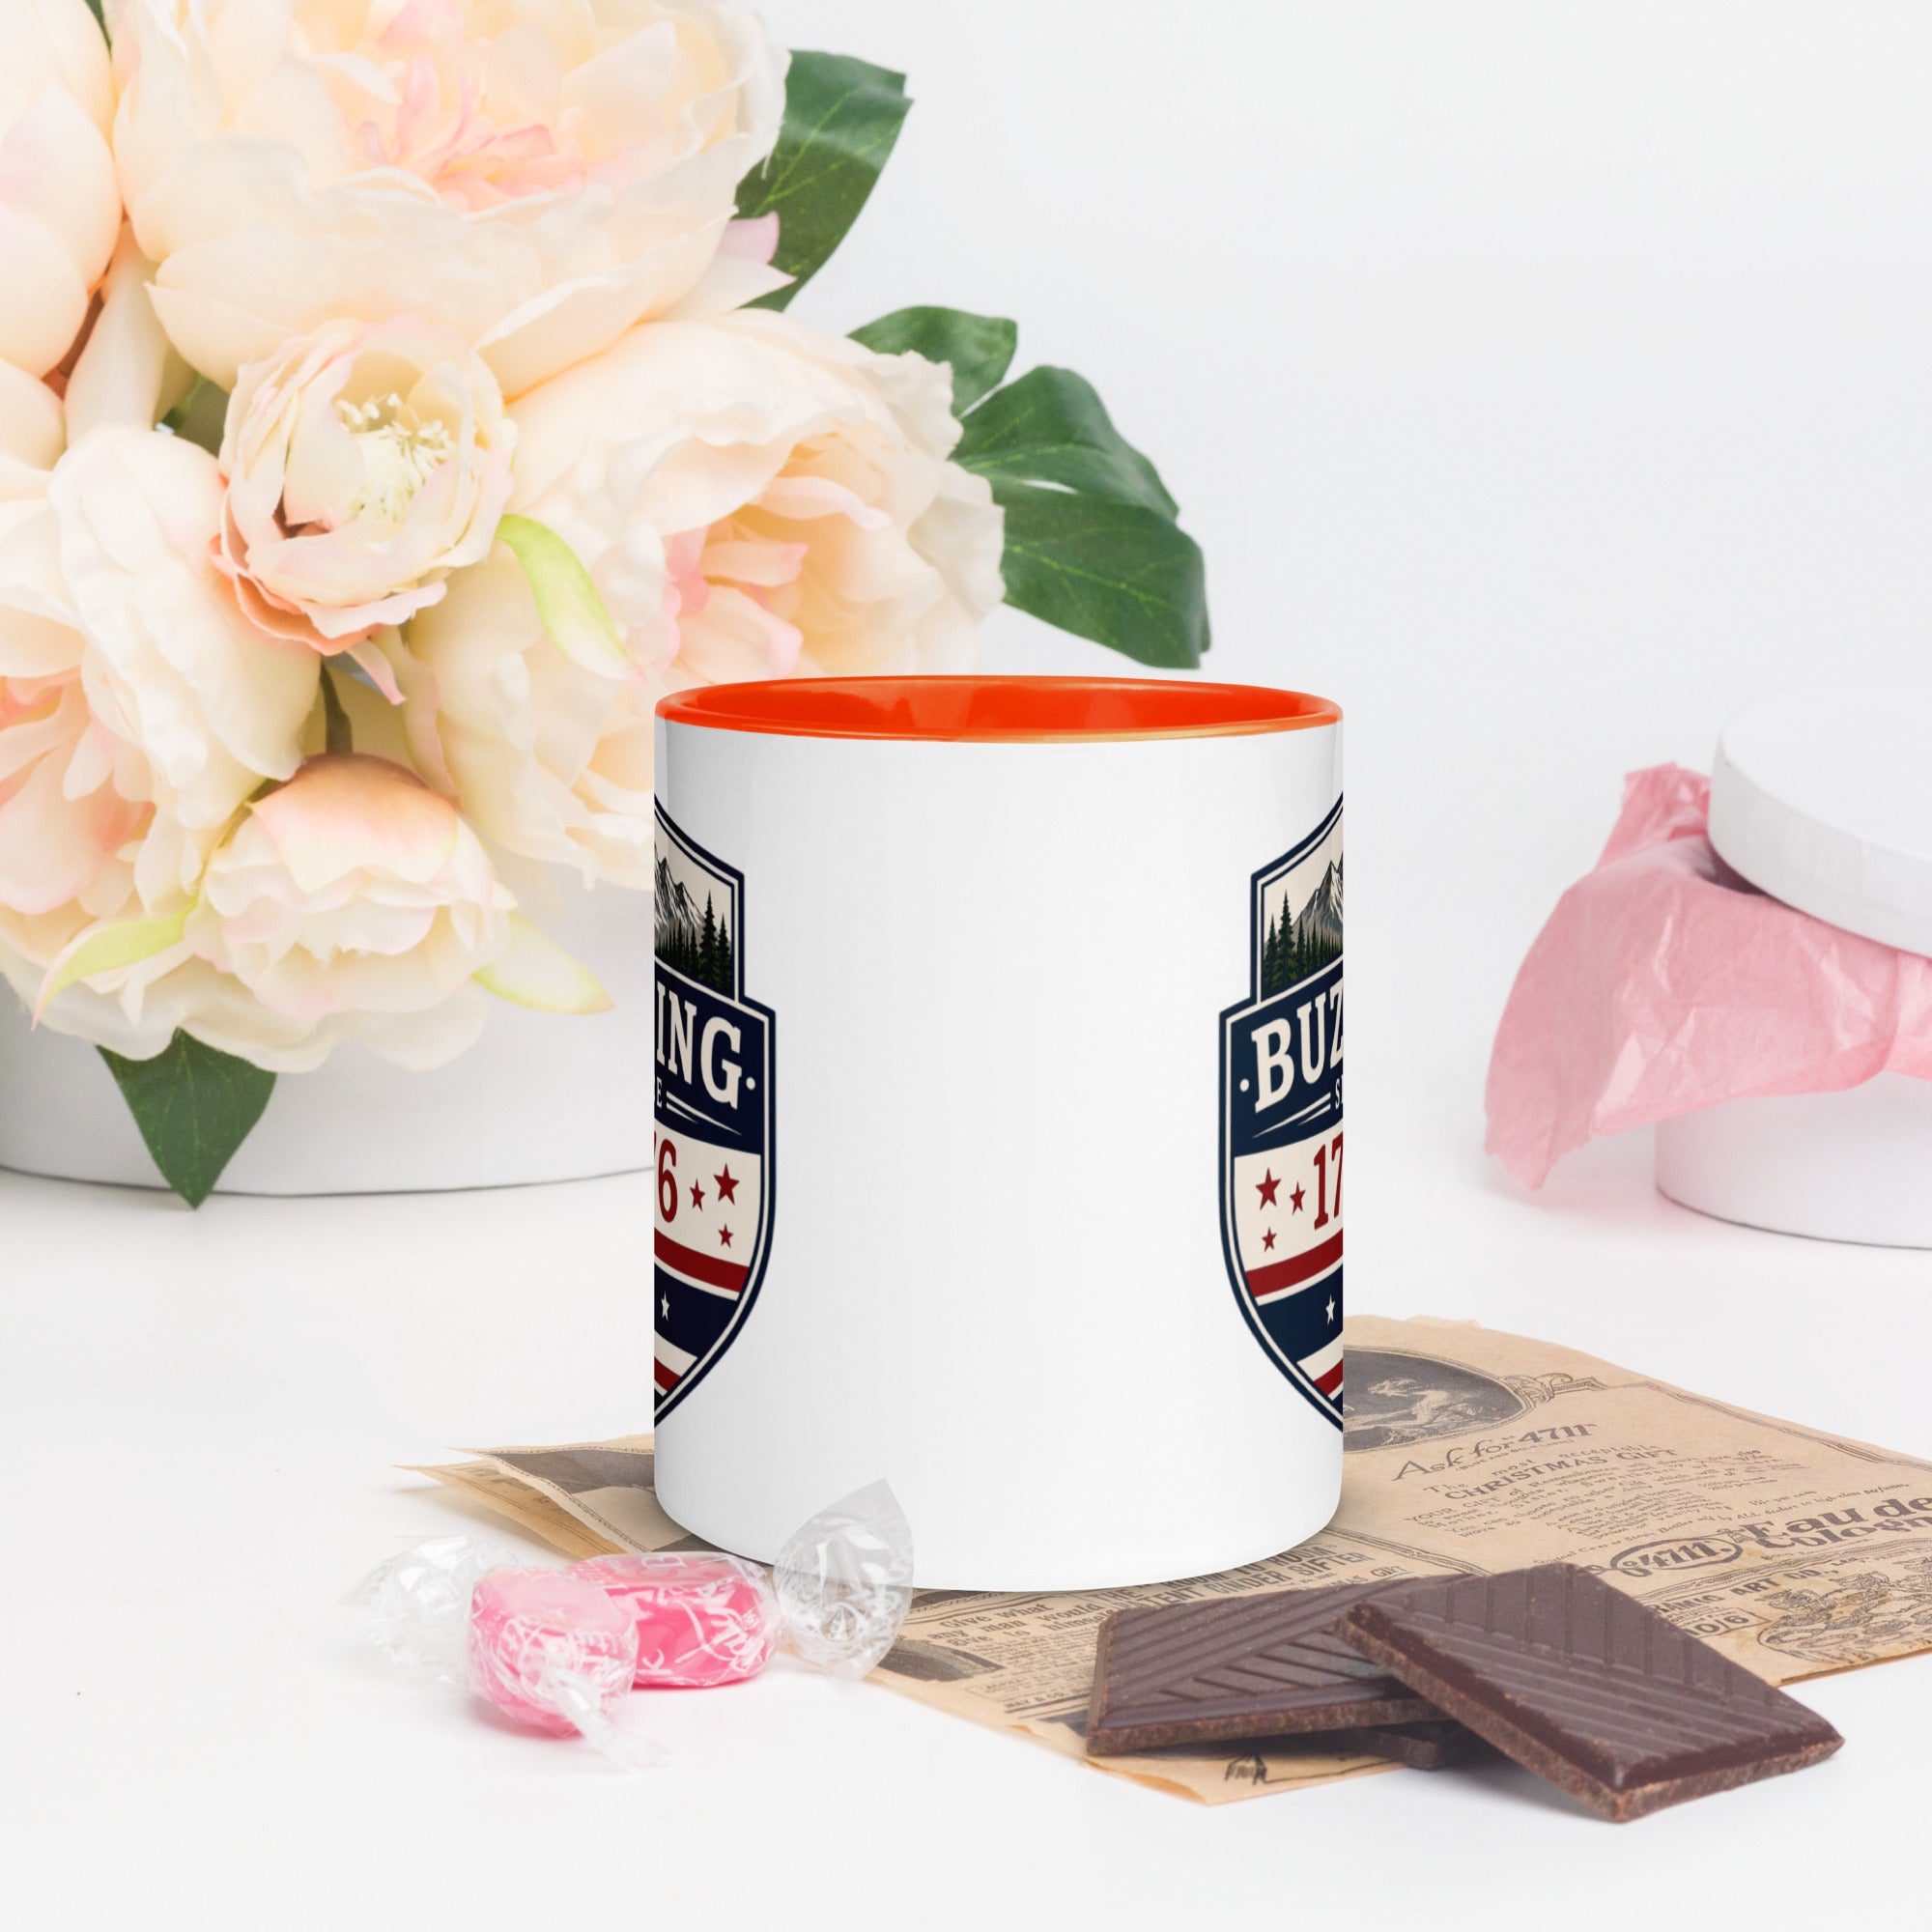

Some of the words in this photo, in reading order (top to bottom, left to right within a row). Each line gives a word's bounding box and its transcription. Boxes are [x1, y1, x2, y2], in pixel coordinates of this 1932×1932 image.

[1250, 976, 1343, 1114] BUZ
[654, 1130, 678, 1223] 6
[1313, 1130, 1343, 1231] 17
[1391, 1447, 1463, 1482] Ask
[1470, 1438, 1515, 1458] for
[1444, 1456, 1608, 1499] CHRISTMAS
[1616, 1449, 1678, 1461] GIFT
[1492, 1459, 1534, 1476] most
[1739, 1507, 1869, 1539] Eau
[1872, 1497, 1932, 1519] de
[1287, 1551, 1377, 1577] SIFTER
[1730, 1577, 1781, 1596] ART
[926, 1628, 970, 1641] any
[978, 1619, 1027, 1633] man
[1035, 1601, 1105, 1623] would
[939, 1614, 992, 1630] Give
[996, 1602, 1054, 1620] what
